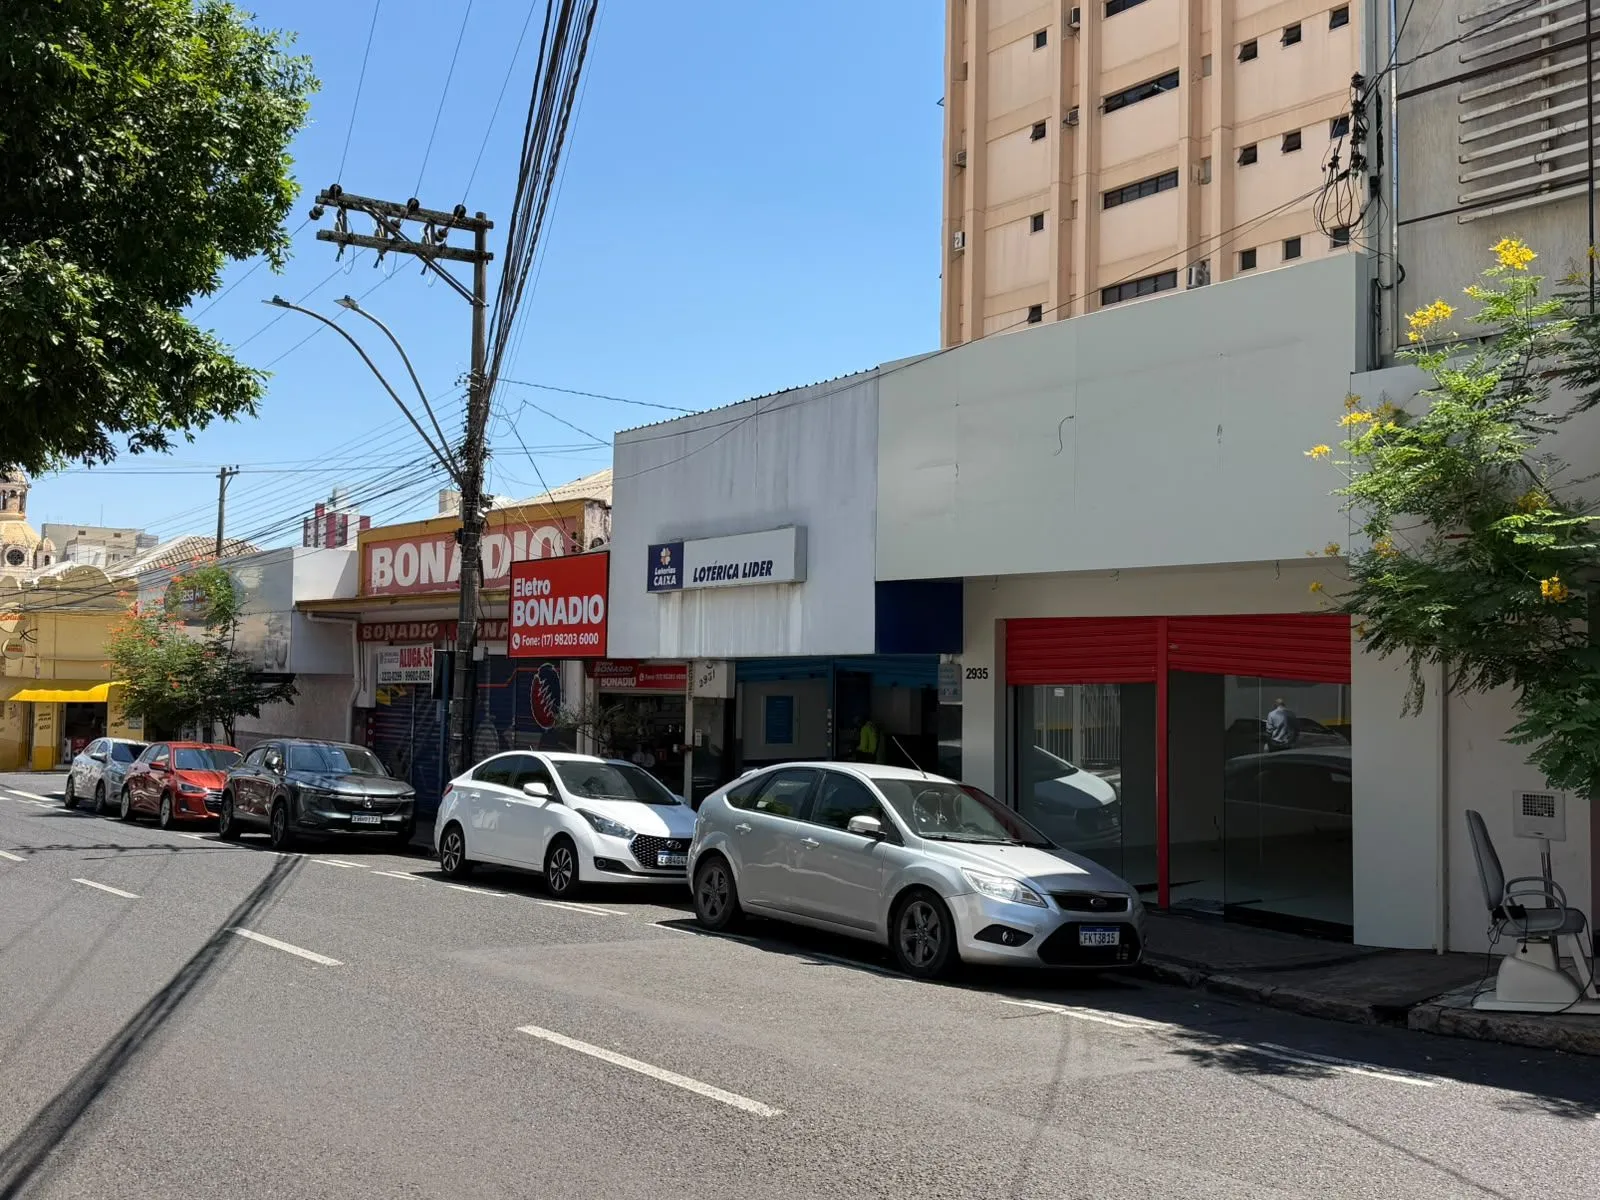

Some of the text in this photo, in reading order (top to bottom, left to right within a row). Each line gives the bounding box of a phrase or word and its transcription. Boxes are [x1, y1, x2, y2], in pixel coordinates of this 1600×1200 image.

[654, 565, 676, 576] Loterias
[692, 559, 773, 583] LOTÉRICA LIDER
[513, 577, 551, 597] Eletro
[653, 575, 677, 586] CAIXA
[512, 594, 605, 627] BONADIO
[362, 622, 439, 640] BONADIO
[522, 632, 599, 648] Fone: (17) 98203 6000
[966, 667, 989, 680] 2935
